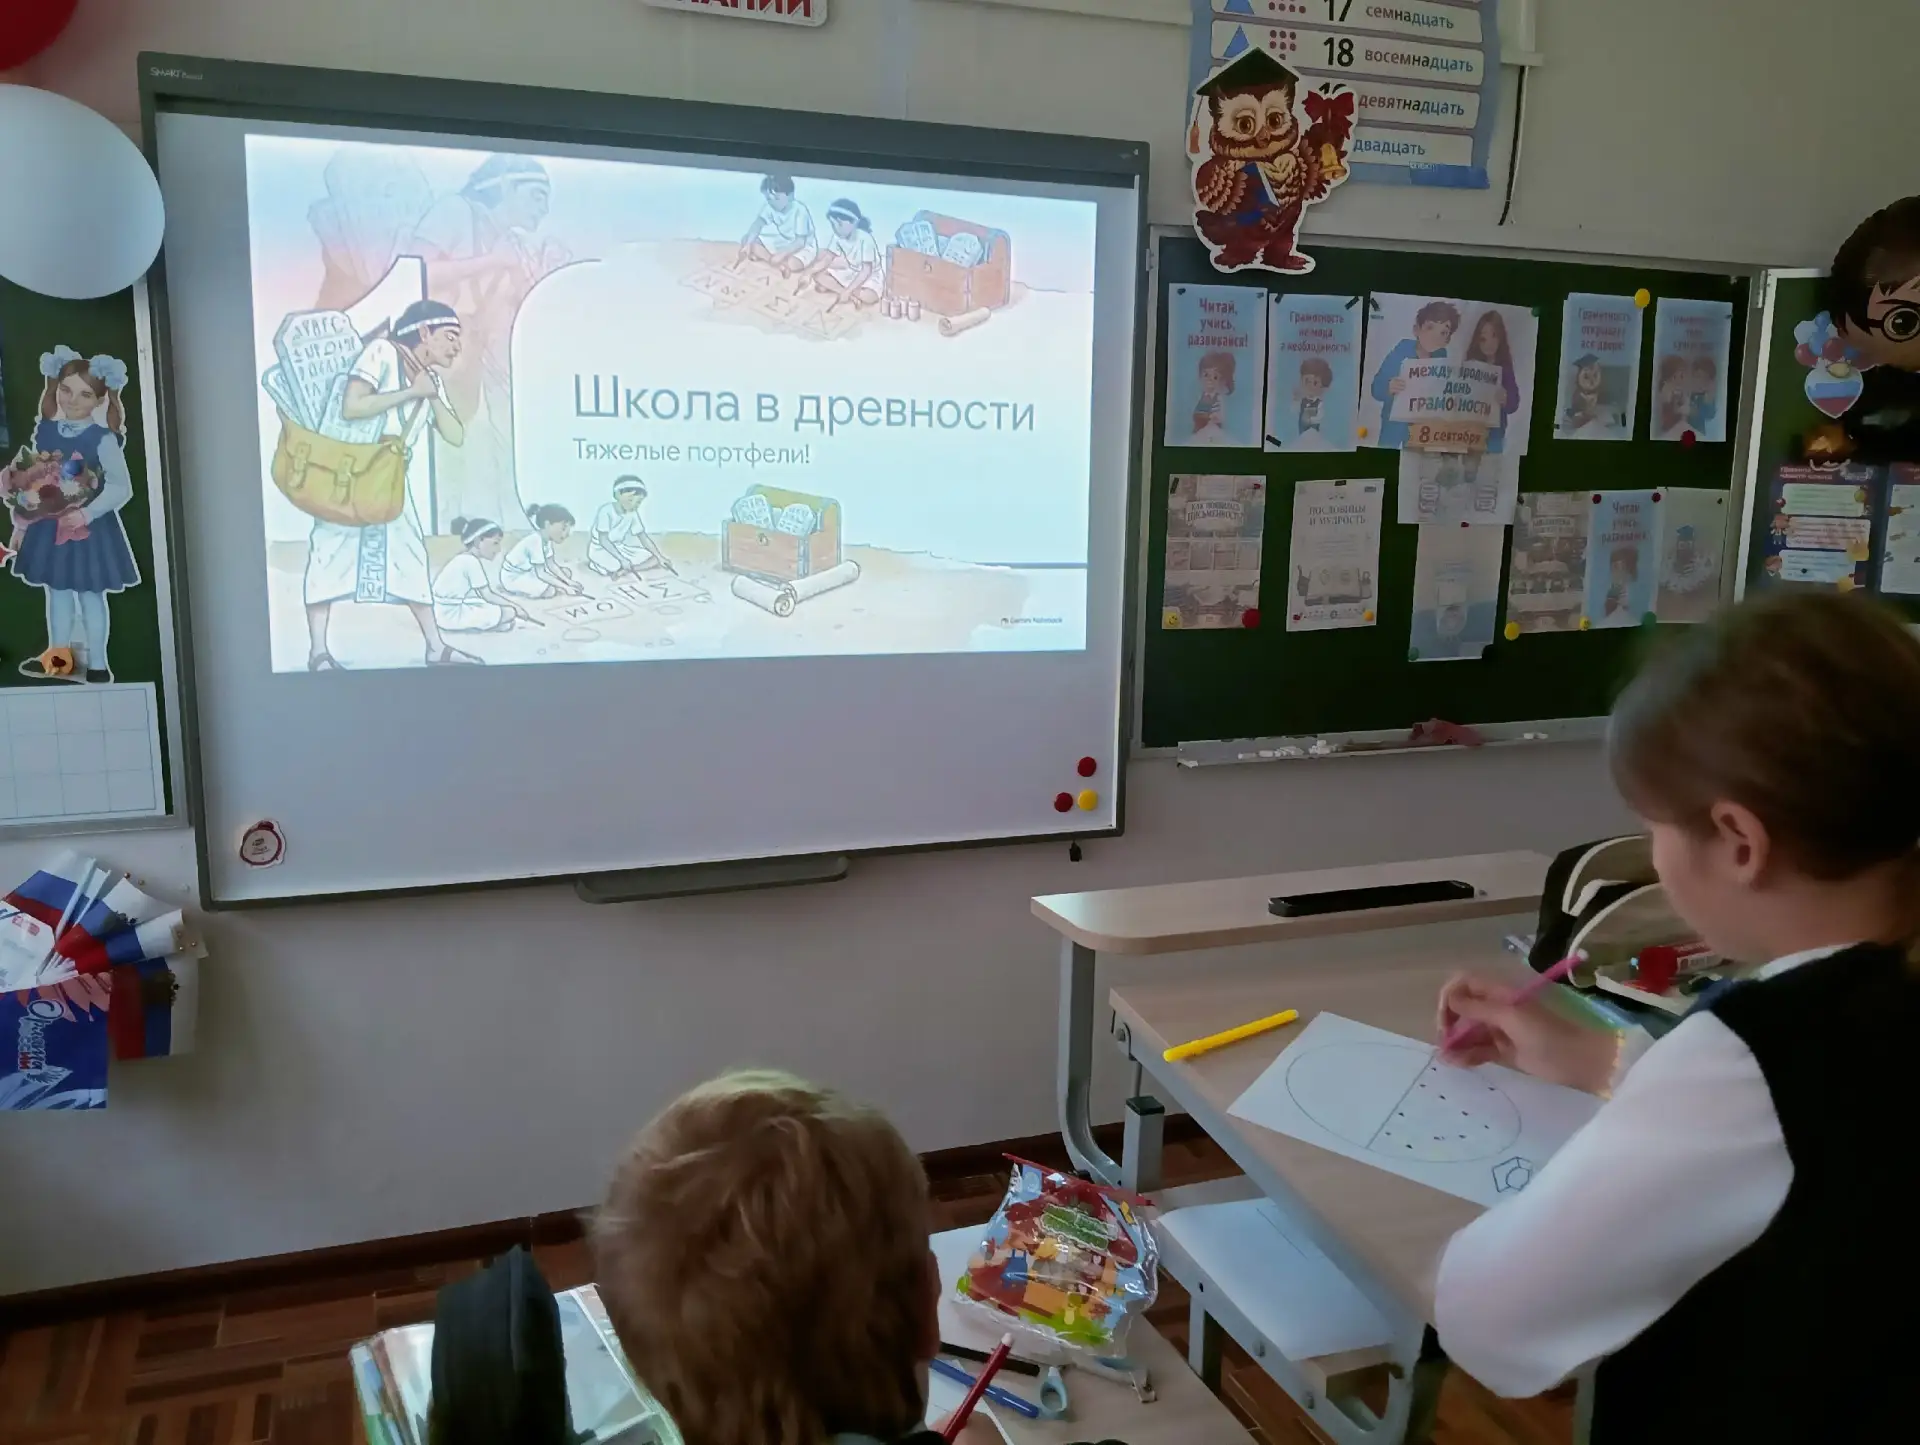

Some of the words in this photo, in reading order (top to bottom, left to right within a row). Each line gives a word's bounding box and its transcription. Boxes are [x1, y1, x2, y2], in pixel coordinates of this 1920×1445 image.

[1366, 4, 1454, 30] семнадцать
[1323, 37, 1354, 67] 18
[1364, 48, 1474, 73] восемнадцать
[1358, 92, 1465, 117] девятнадцать
[1353, 138, 1426, 157] двадцать
[574, 373, 740, 422] Школа
[756, 392, 780, 423] в
[794, 391, 1035, 436] древности
[1419, 425, 1430, 443] 8
[573, 438, 680, 462] Тяжелые
[687, 442, 811, 469] портфели!
